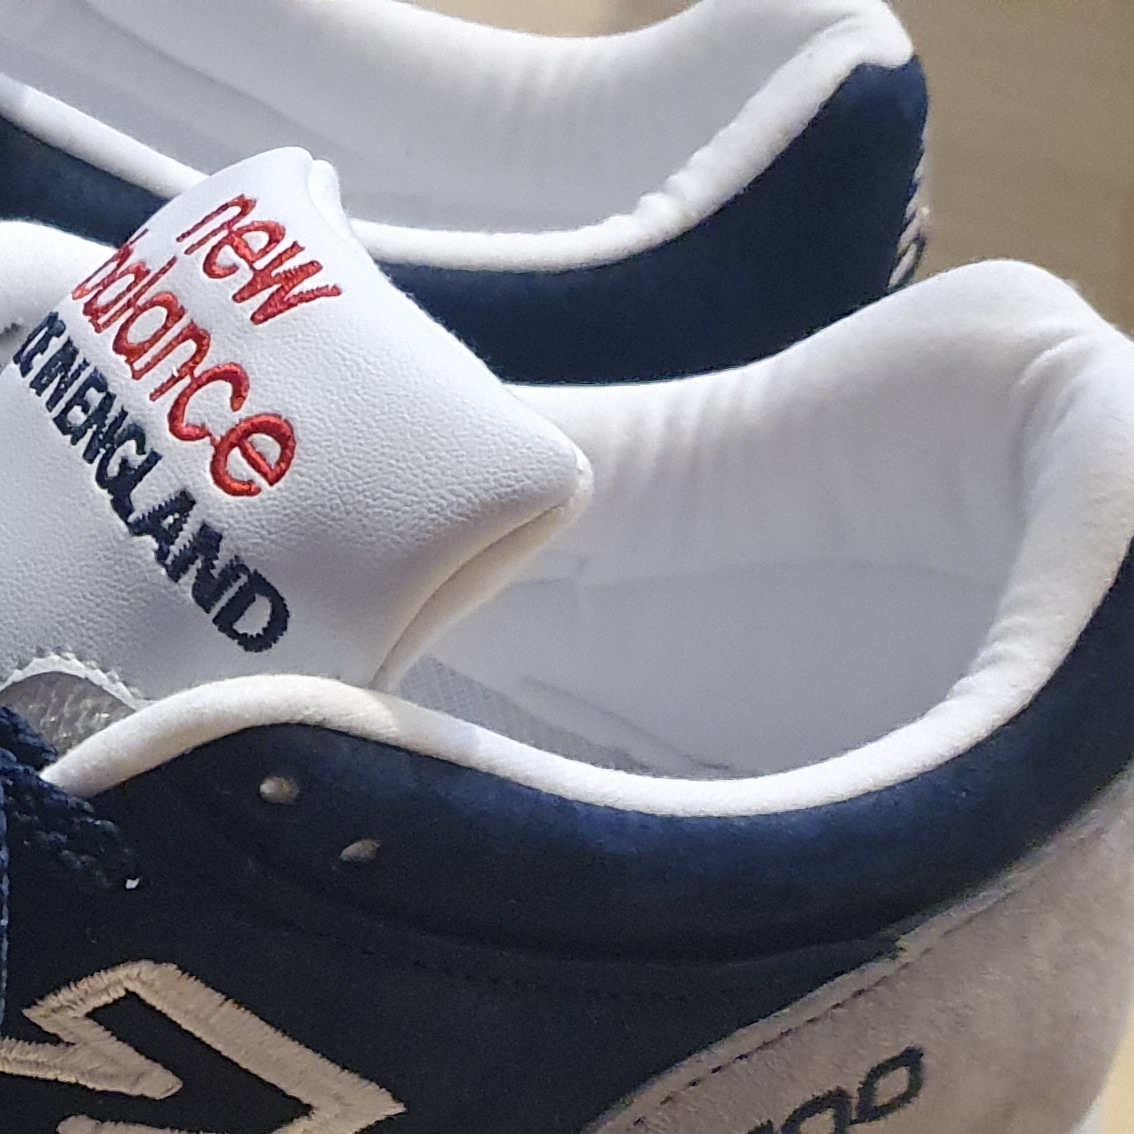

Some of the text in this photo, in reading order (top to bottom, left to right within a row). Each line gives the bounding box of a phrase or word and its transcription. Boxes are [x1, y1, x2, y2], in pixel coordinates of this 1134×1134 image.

[72, 229, 297, 497] balance
[177, 194, 343, 325] new
[53, 366, 290, 652] ENGLAND
